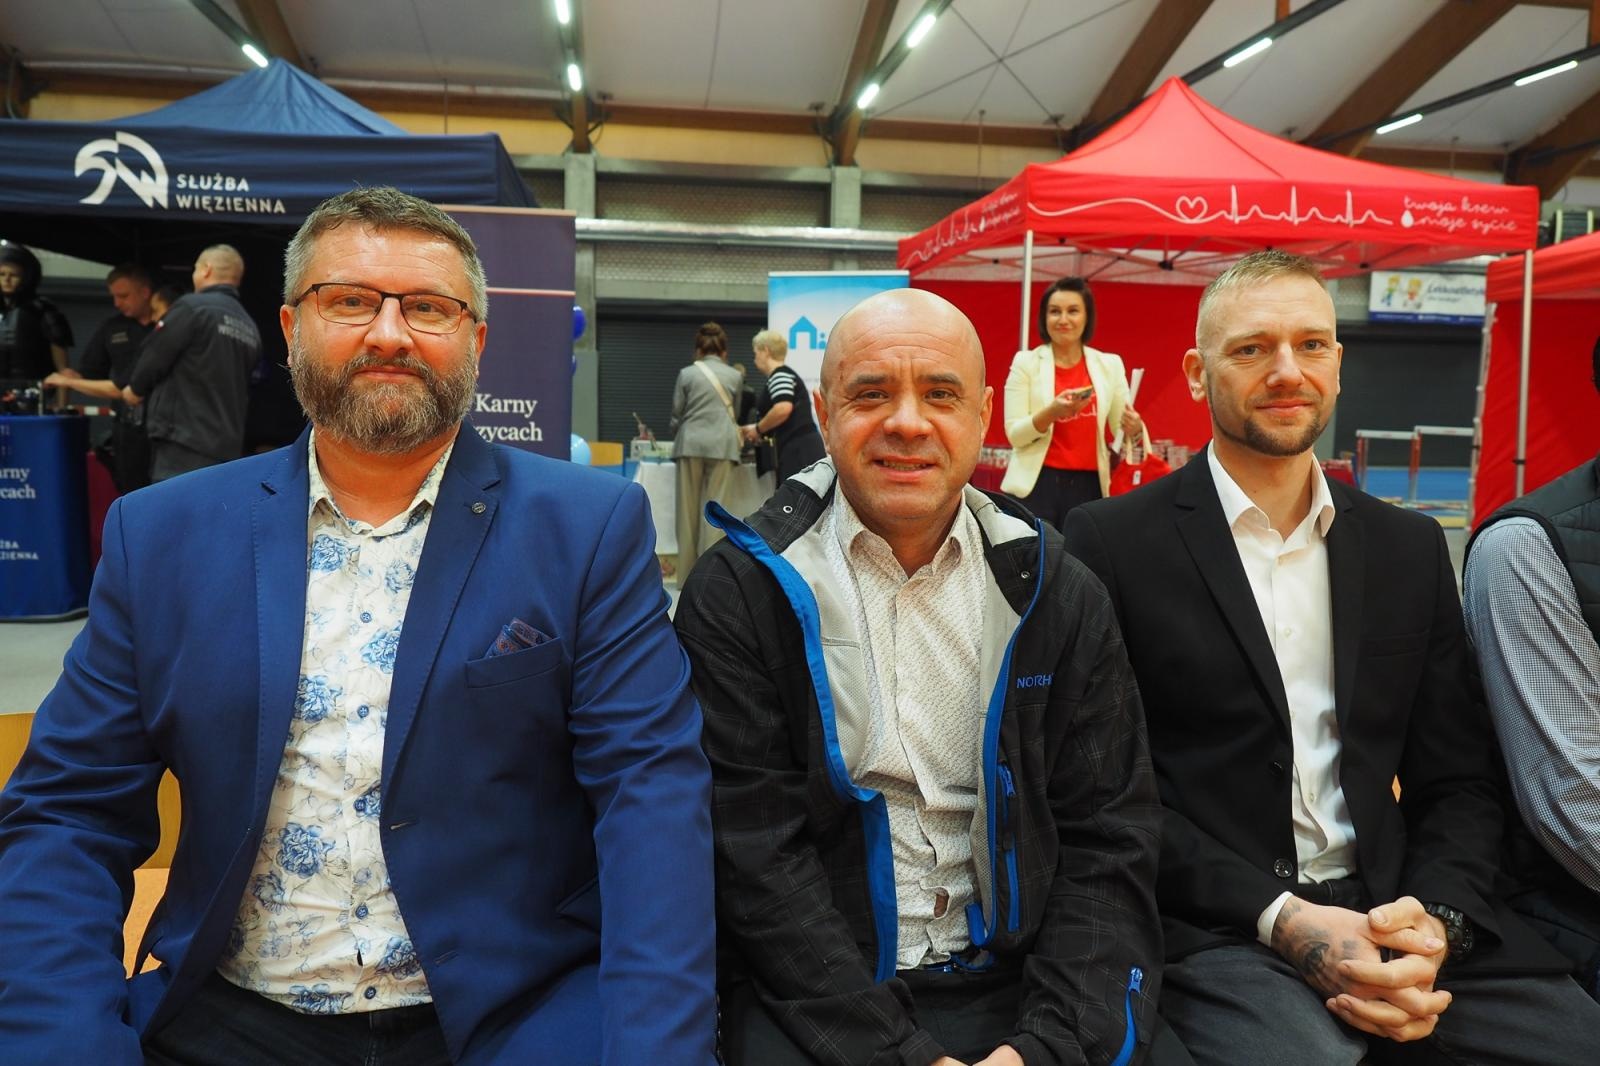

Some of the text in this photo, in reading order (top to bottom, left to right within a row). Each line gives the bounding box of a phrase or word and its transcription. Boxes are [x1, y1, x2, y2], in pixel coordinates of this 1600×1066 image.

[176, 173, 249, 192] SŁUŻBA
[175, 194, 286, 214] WIĘZIENNA
[475, 393, 538, 418] Karny
